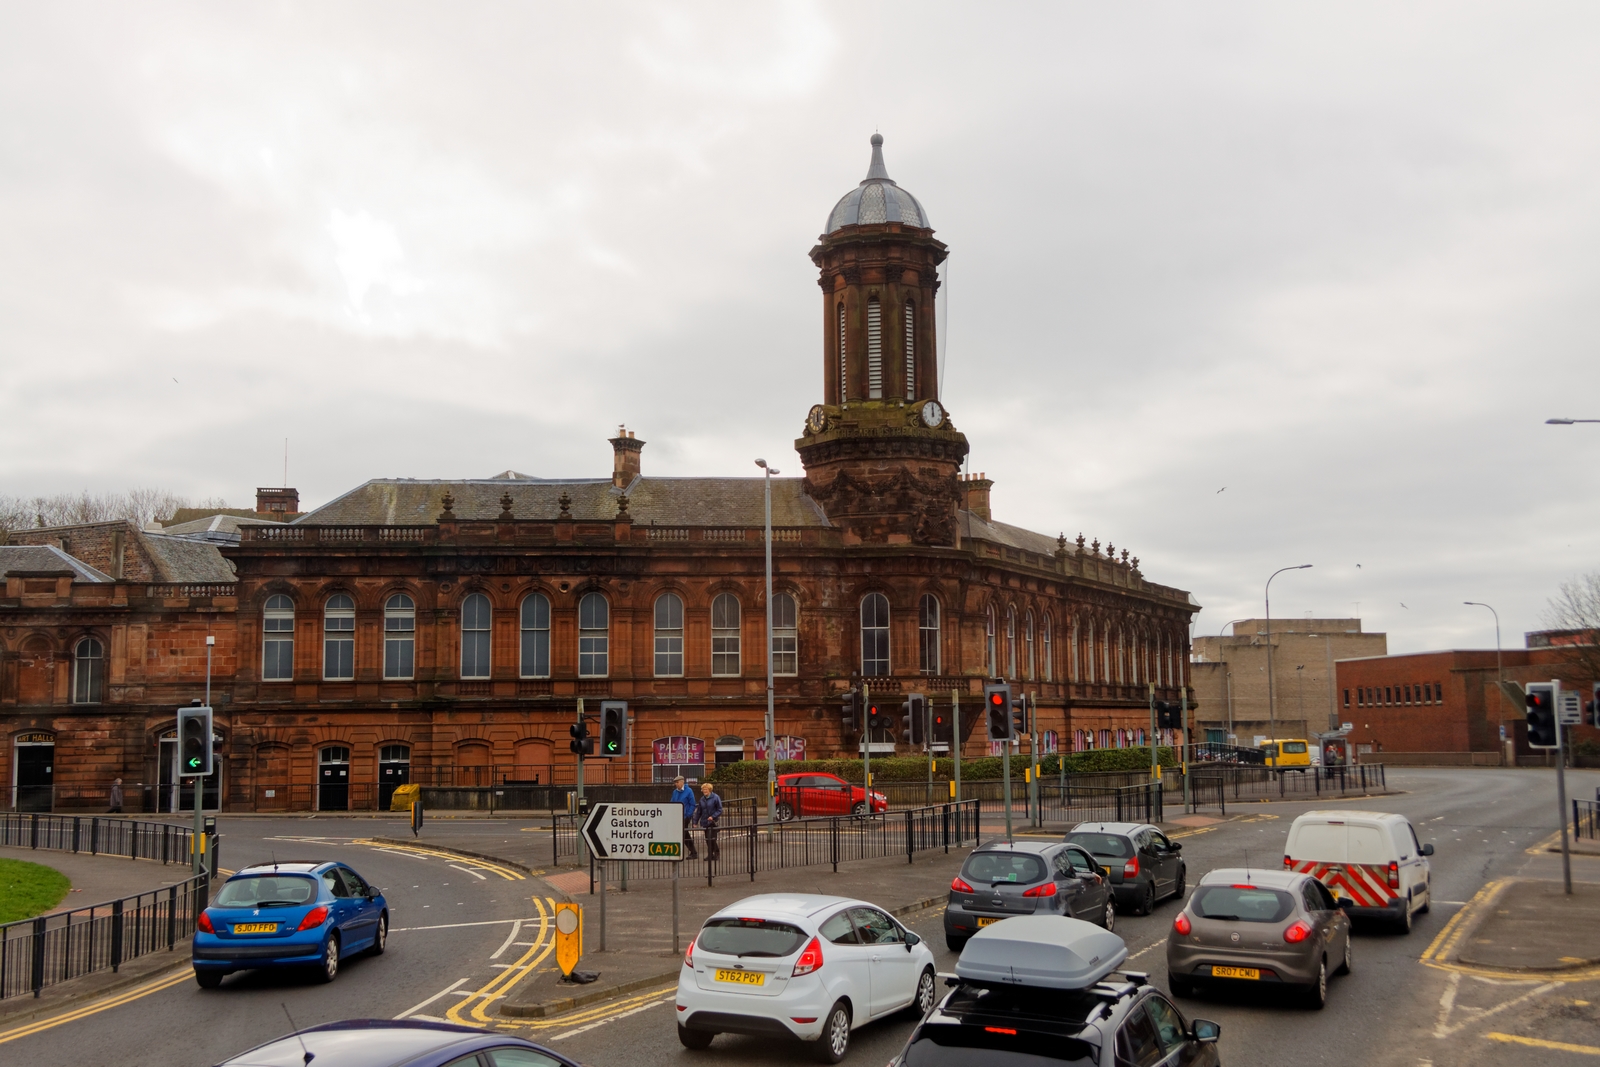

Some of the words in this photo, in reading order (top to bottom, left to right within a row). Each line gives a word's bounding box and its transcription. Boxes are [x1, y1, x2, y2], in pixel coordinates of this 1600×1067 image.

[836, 429, 851, 438] THE
[891, 428, 906, 437] THE
[659, 743, 697, 751] PALACE
[755, 737, 804, 752] WAT'S
[658, 752, 699, 760] THEATRE
[611, 807, 663, 818] Edinburgh
[611, 818, 650, 828] Galston
[611, 830, 654, 839] Hurlford
[237, 924, 258, 933] SJ07
[719, 970, 742, 982] ST62
[742, 973, 762, 984] PGY
[1215, 967, 1237, 976] SR07
[1238, 968, 1256, 978] CMU
